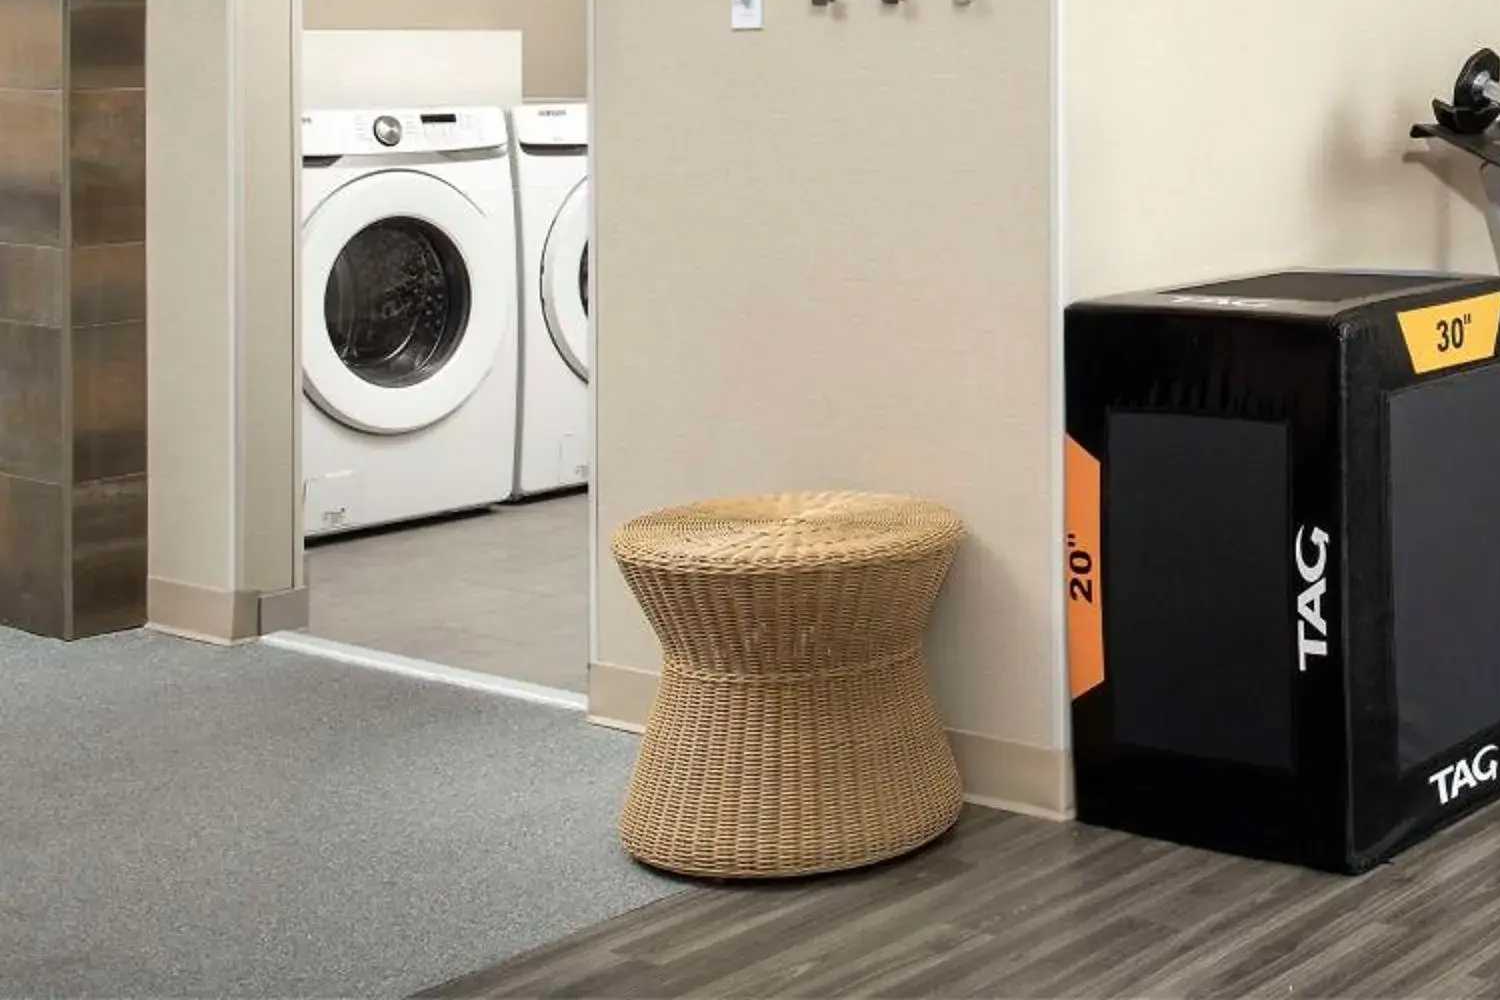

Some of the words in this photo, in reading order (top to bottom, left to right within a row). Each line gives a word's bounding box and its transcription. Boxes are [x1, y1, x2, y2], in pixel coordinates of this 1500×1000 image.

[1436, 313, 1471, 352] 30"
[1067, 533, 1093, 604] 20"
[1296, 525, 1329, 672] TAG
[1428, 744, 1499, 804] TAG
